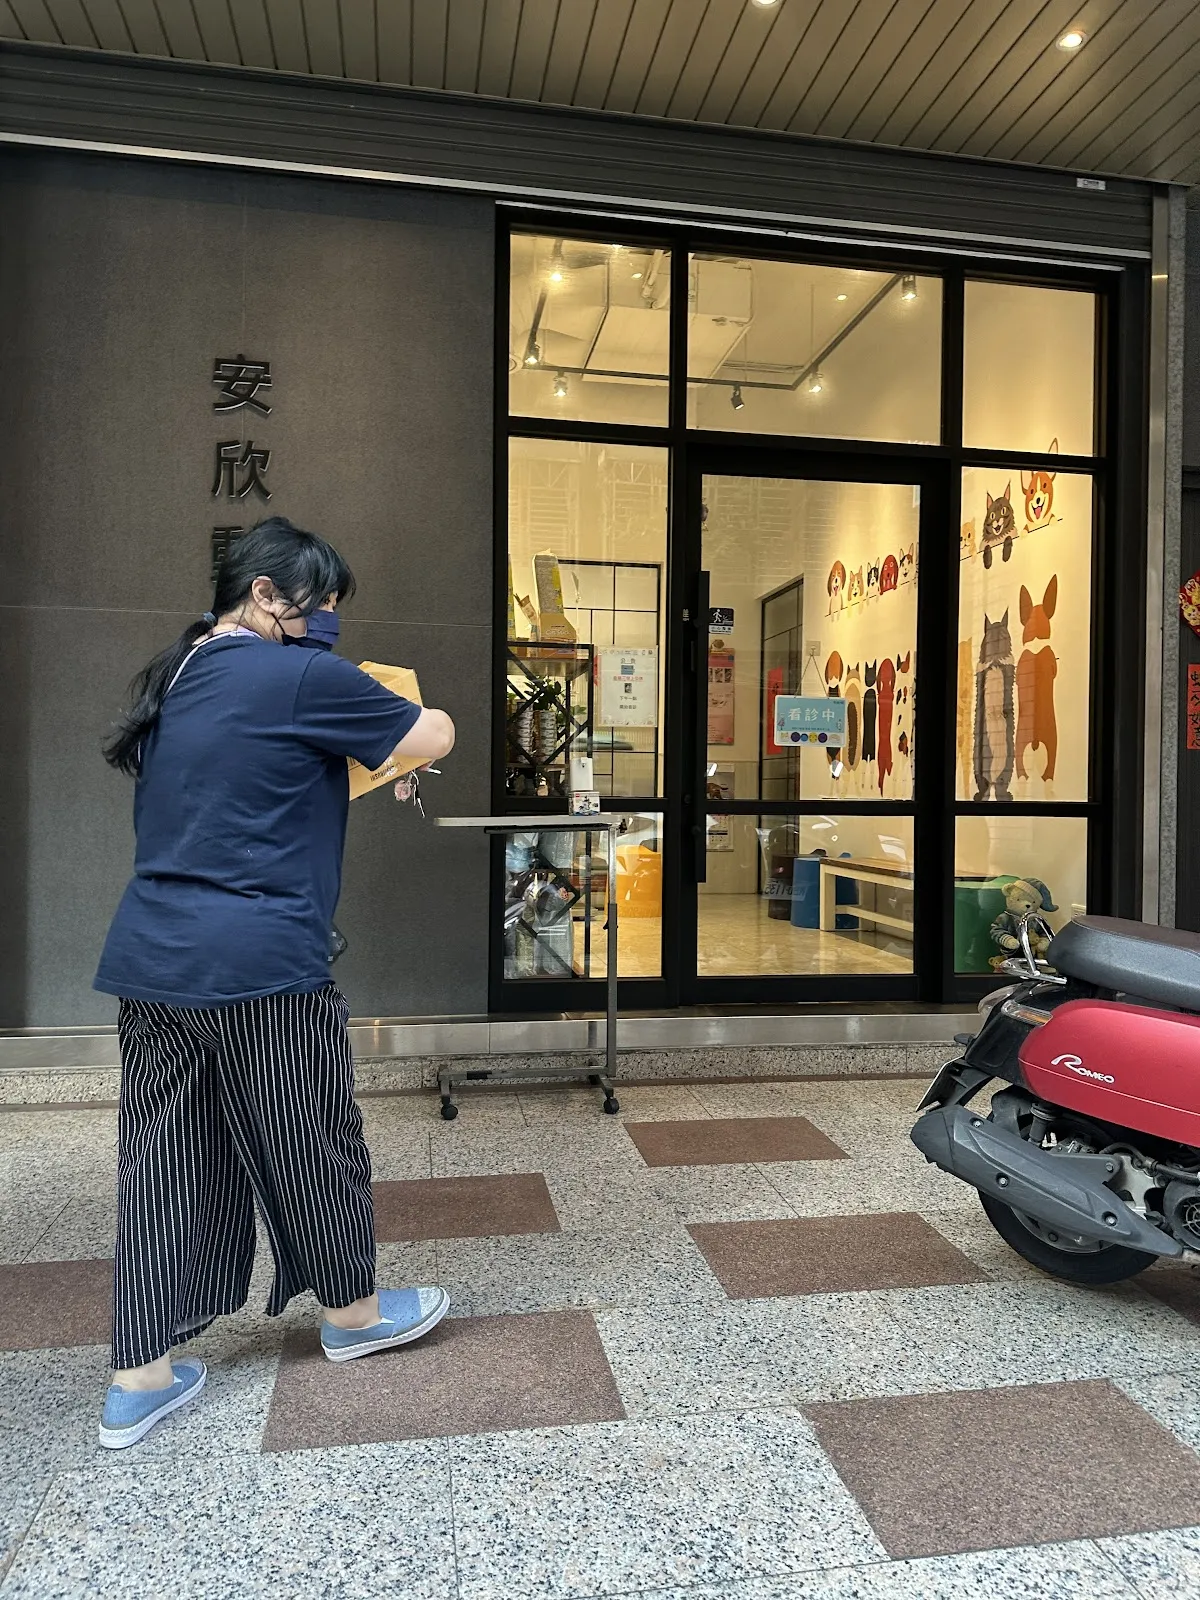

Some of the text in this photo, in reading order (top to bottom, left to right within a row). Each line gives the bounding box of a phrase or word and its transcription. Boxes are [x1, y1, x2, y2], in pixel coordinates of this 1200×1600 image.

[788, 707, 835, 722] 看診中
[1050, 1053, 1115, 1084] ROMEO
